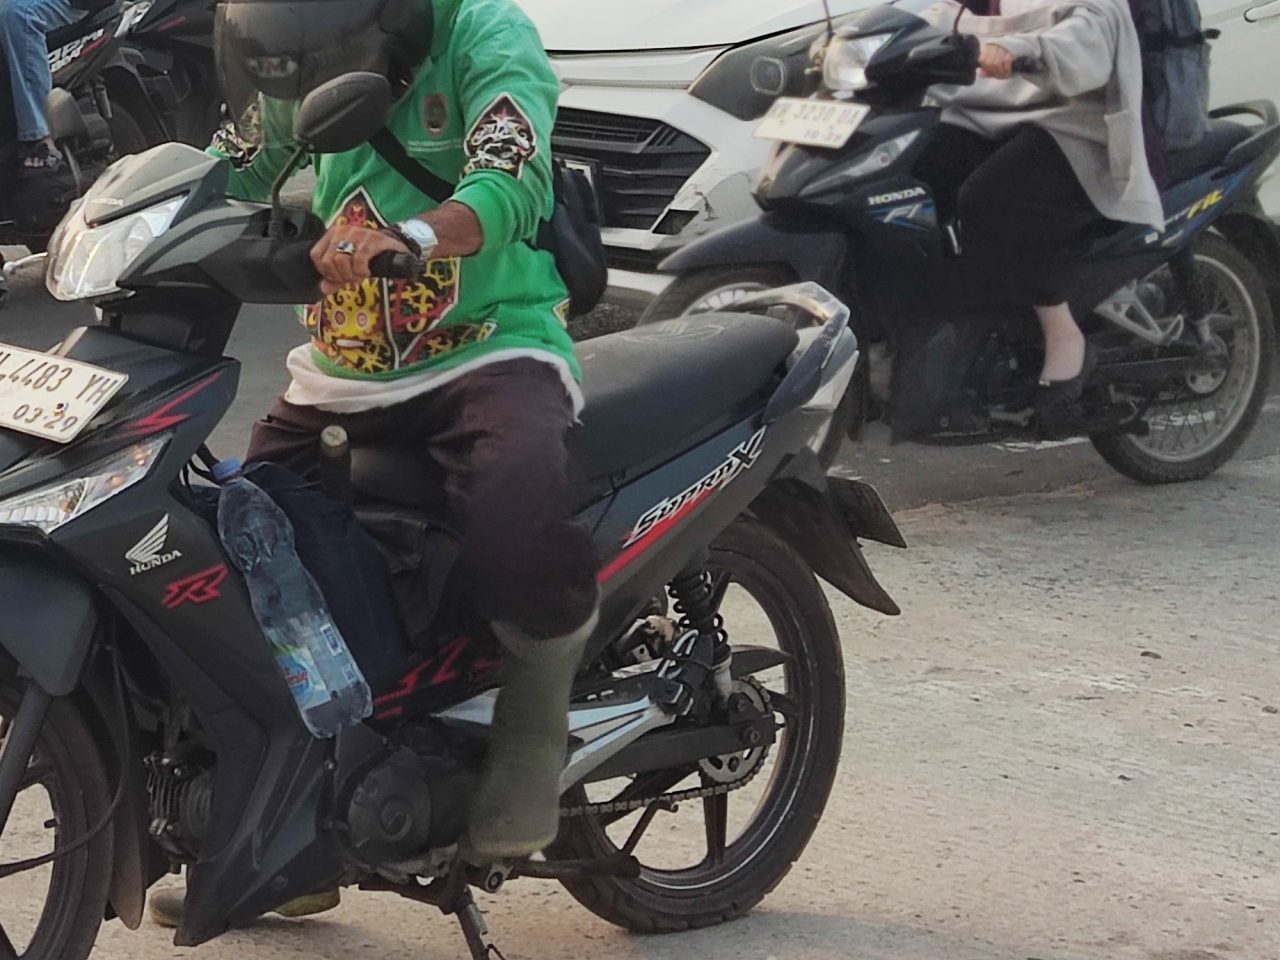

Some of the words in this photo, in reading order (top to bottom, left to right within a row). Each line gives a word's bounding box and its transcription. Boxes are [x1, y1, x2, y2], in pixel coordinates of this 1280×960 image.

[868, 187, 925, 205] HONDA
[8, 359, 72, 392] 4483
[76, 374, 119, 405] YH
[129, 549, 182, 576] HONDA
